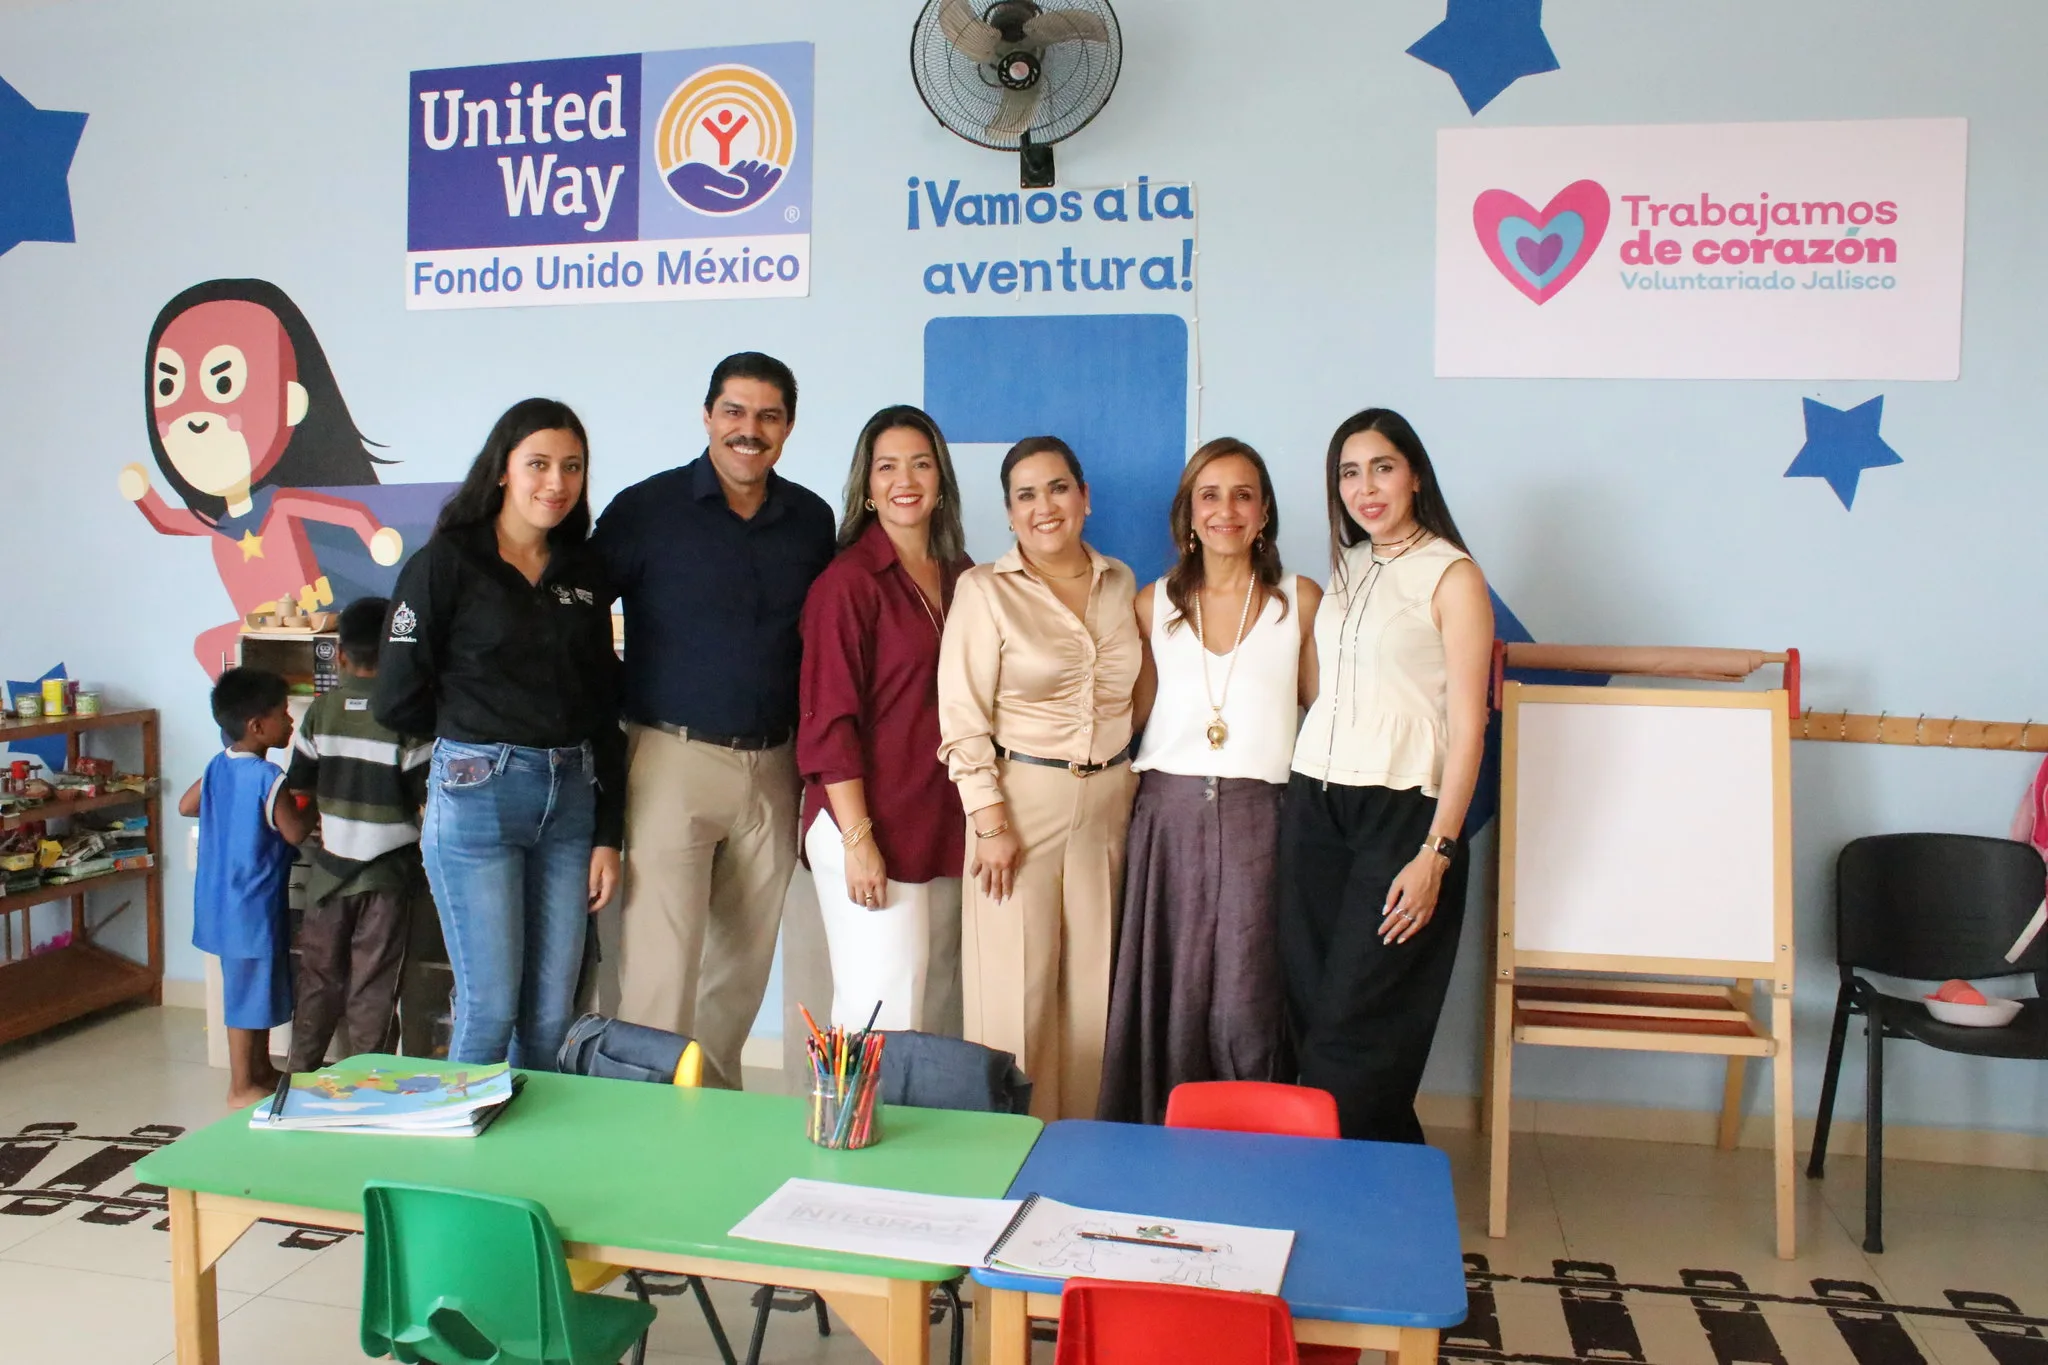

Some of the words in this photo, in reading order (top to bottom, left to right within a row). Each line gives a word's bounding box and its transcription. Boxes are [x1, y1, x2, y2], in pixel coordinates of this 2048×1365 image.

[419, 74, 627, 151] United
[497, 154, 625, 232] Way
[907, 175, 1083, 230] ¡Vamos
[1093, 188, 1129, 222] a
[1138, 175, 1194, 222] la
[1620, 191, 1898, 236] Trabajamos
[413, 256, 523, 296] Fondo
[535, 251, 644, 290] Unido
[657, 246, 800, 287] México
[923, 238, 1194, 295] aventura!
[1619, 230, 1682, 266] de
[1692, 226, 1898, 266] corazón
[1619, 269, 1796, 291] Voluntariado
[1802, 267, 1897, 291] Jalisco
